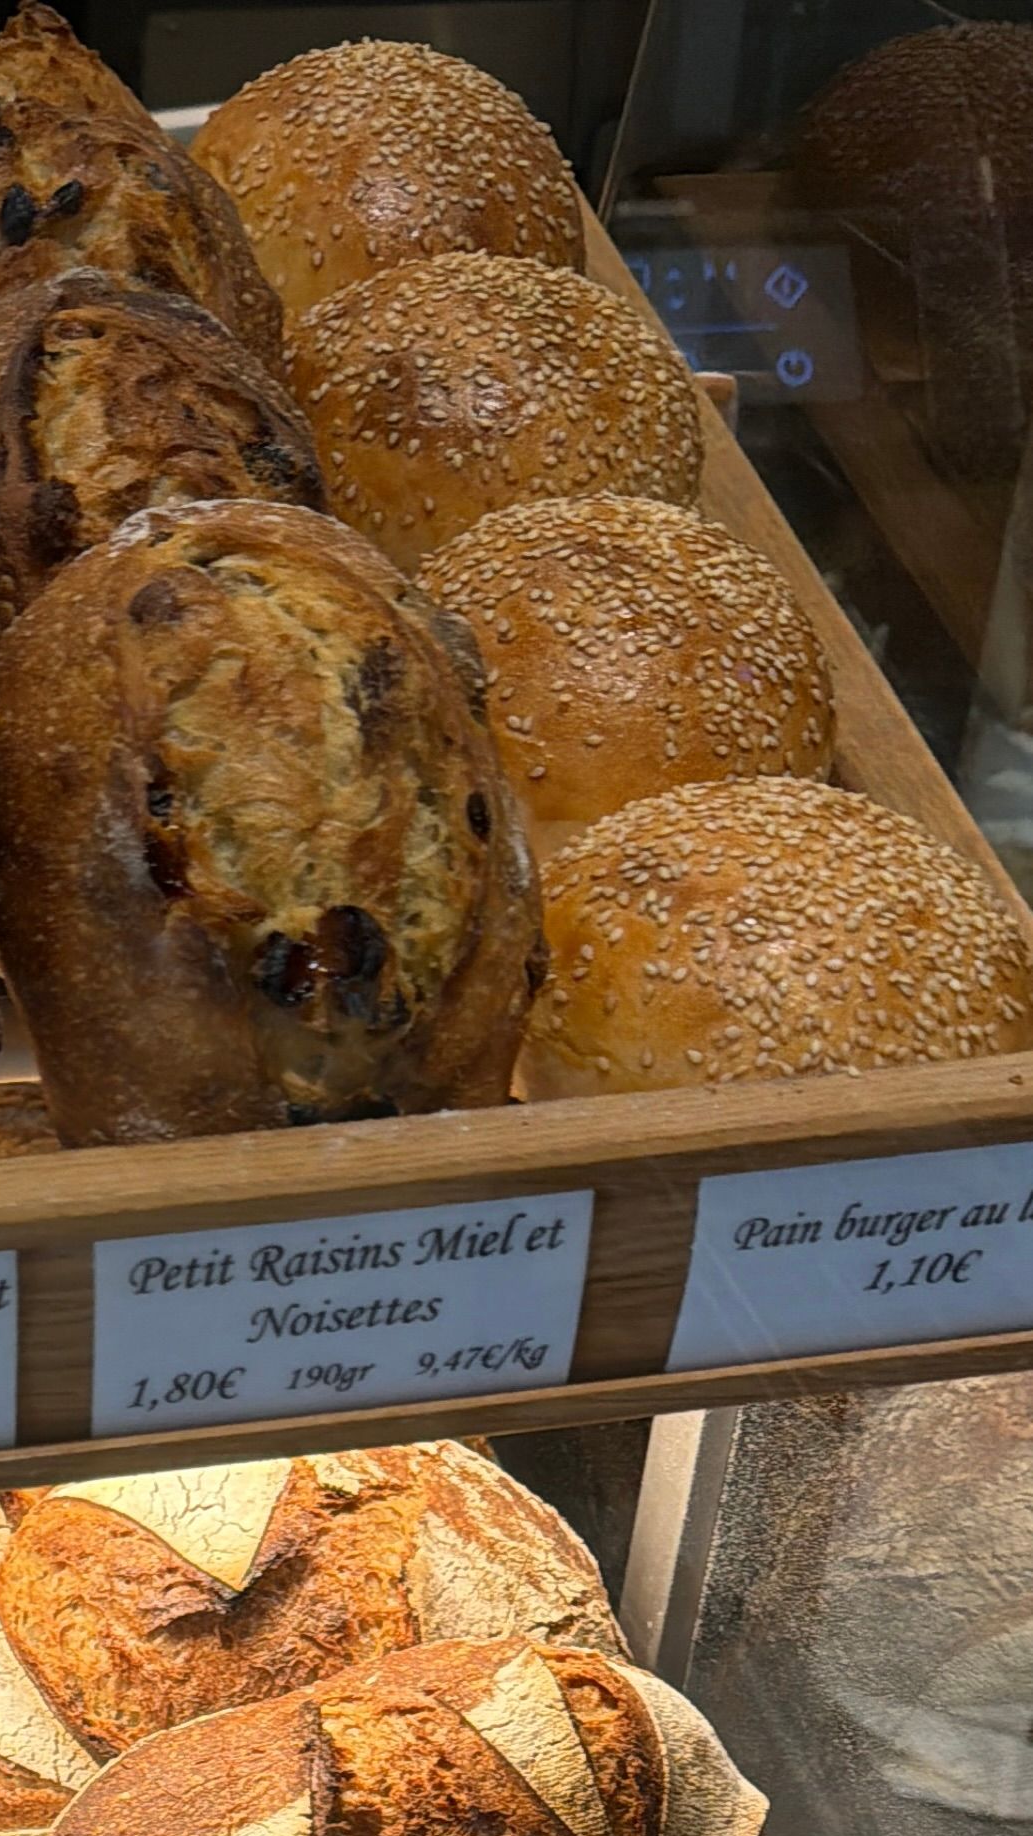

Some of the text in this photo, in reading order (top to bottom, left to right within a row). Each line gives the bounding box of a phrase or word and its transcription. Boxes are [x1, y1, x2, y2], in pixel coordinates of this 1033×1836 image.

[734, 1211, 824, 1250] Pain
[834, 1202, 958, 1246] burger
[960, 1203, 1010, 1228] au
[128, 1212, 566, 1296] Petit Raisins Miel et
[862, 1250, 984, 1294] 1,10€
[246, 1296, 444, 1344] Noisettes
[127, 1336, 550, 1411] 1,80€ 190gr 9,47€/kg
